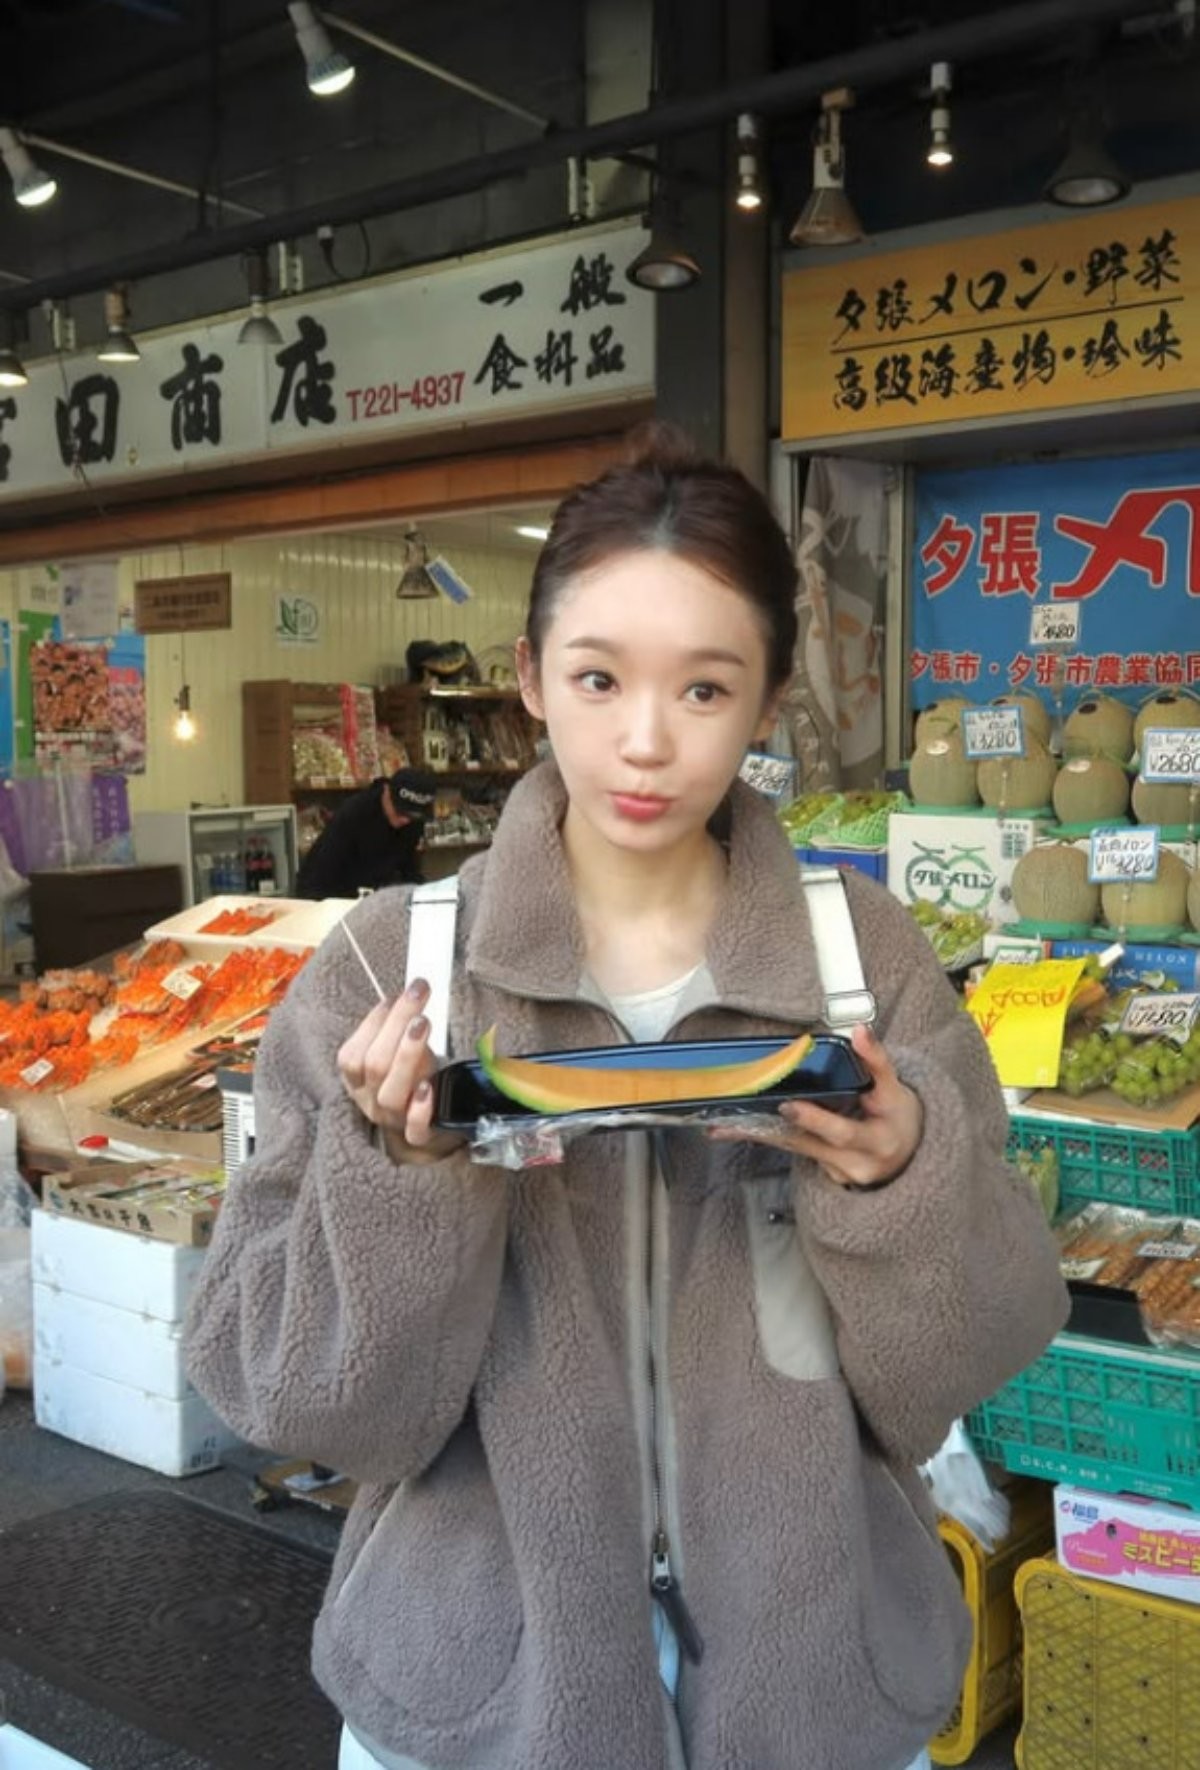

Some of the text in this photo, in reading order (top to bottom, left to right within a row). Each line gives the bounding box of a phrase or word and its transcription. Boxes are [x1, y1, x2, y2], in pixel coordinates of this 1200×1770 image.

[478, 252, 627, 317] 一般
[832, 228, 1182, 344] 夕張メロン・野菜
[473, 325, 626, 395] 食料品
[0, 314, 337, 483] 田商店
[345, 371, 466, 422] T221-4937
